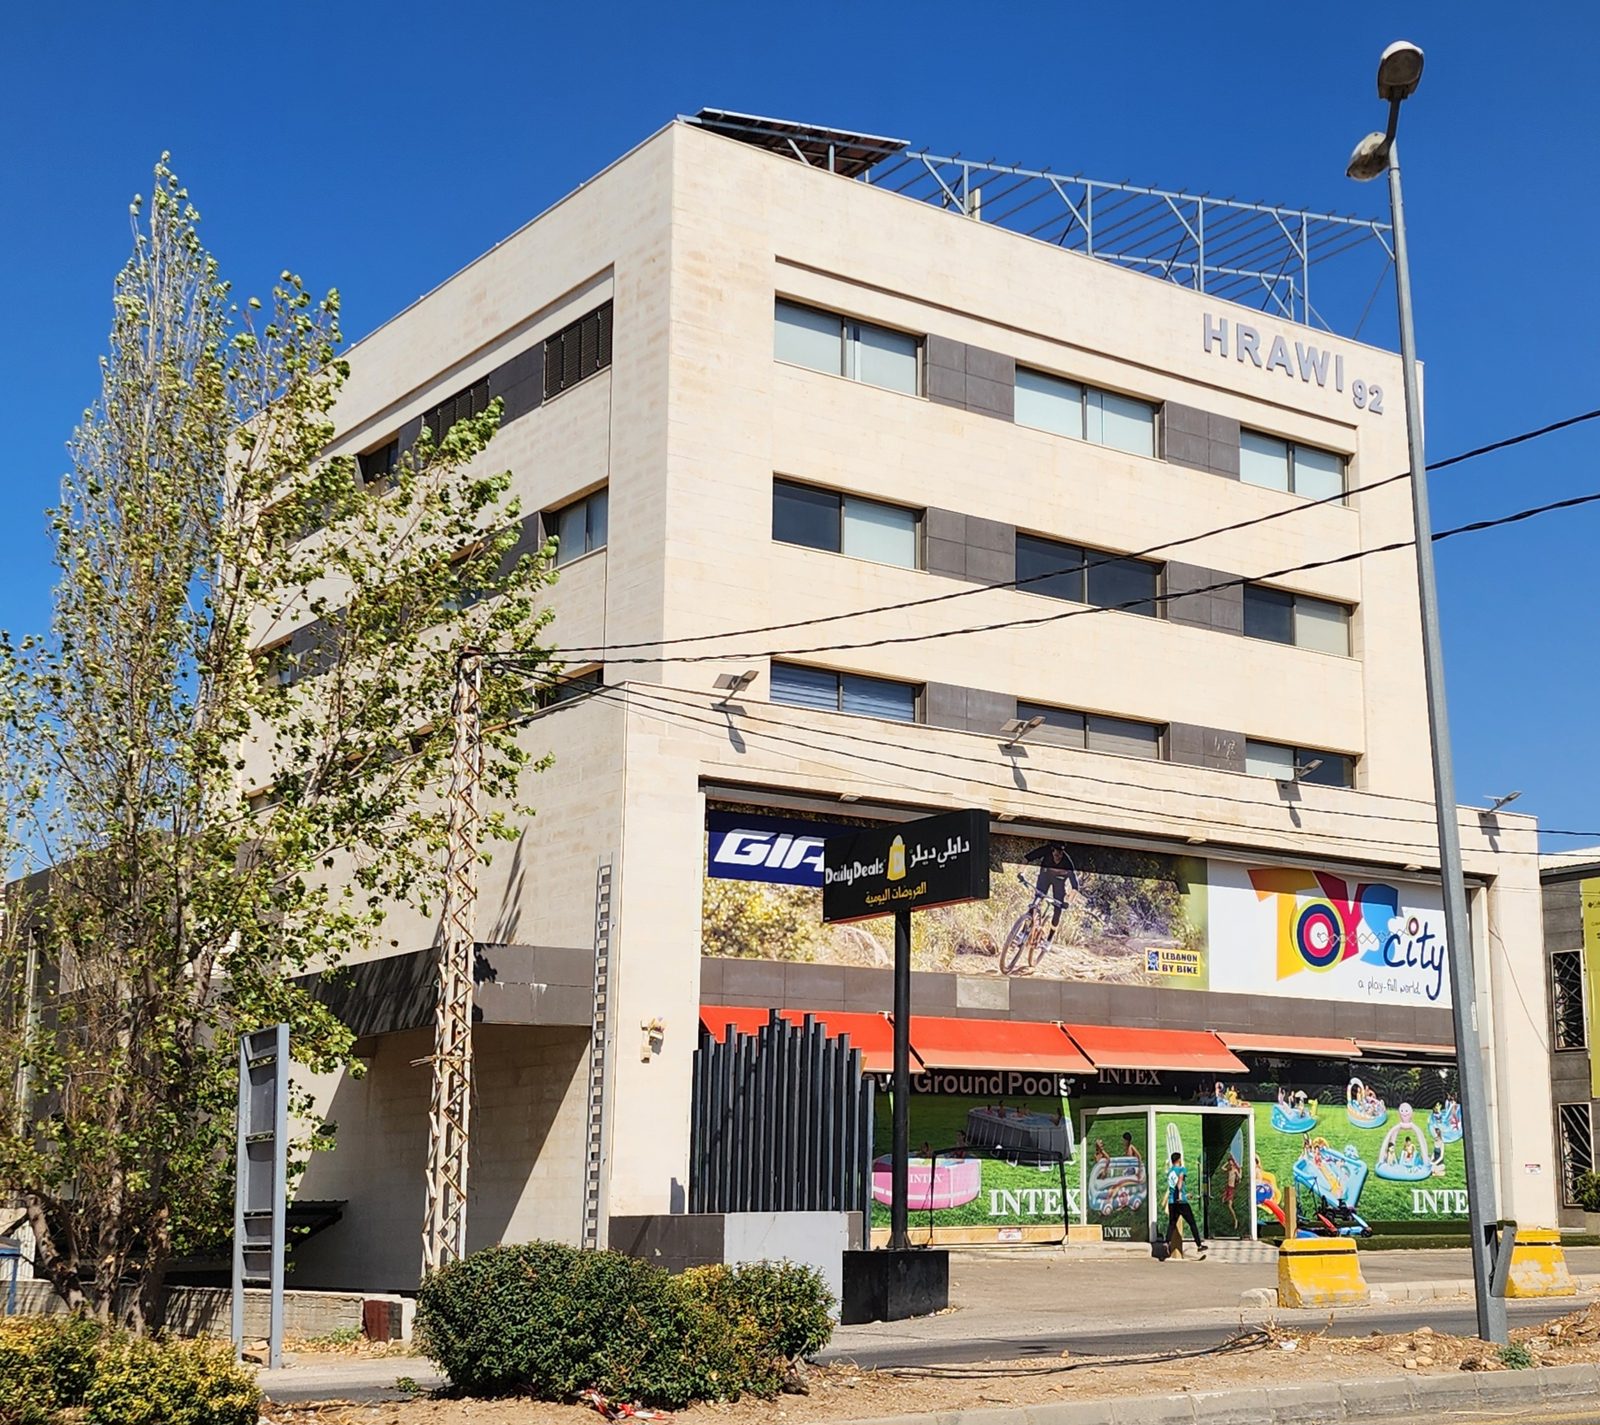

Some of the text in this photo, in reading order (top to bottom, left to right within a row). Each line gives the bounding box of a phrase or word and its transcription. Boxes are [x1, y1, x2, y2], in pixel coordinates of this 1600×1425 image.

[1203, 312, 1384, 415] HRAWI 92
[909, 835, 970, 868] دايلي ديلز
[865, 881, 927, 907] العروضات اليومية
[1247, 867, 1398, 981] TOYS
[1161, 951, 1198, 962] LEBANON
[1162, 964, 1198, 974] BY BIKE
[1383, 915, 1445, 1000] city
[1358, 979, 1364, 989] a
[1400, 981, 1420, 994] world
[913, 1070, 1001, 1095] Ground
[1008, 1072, 1073, 1096] Pools
[1098, 1067, 1161, 1086] INTEX
[989, 1188, 1081, 1216] INTEX
[1104, 1226, 1131, 1239] INTEX
